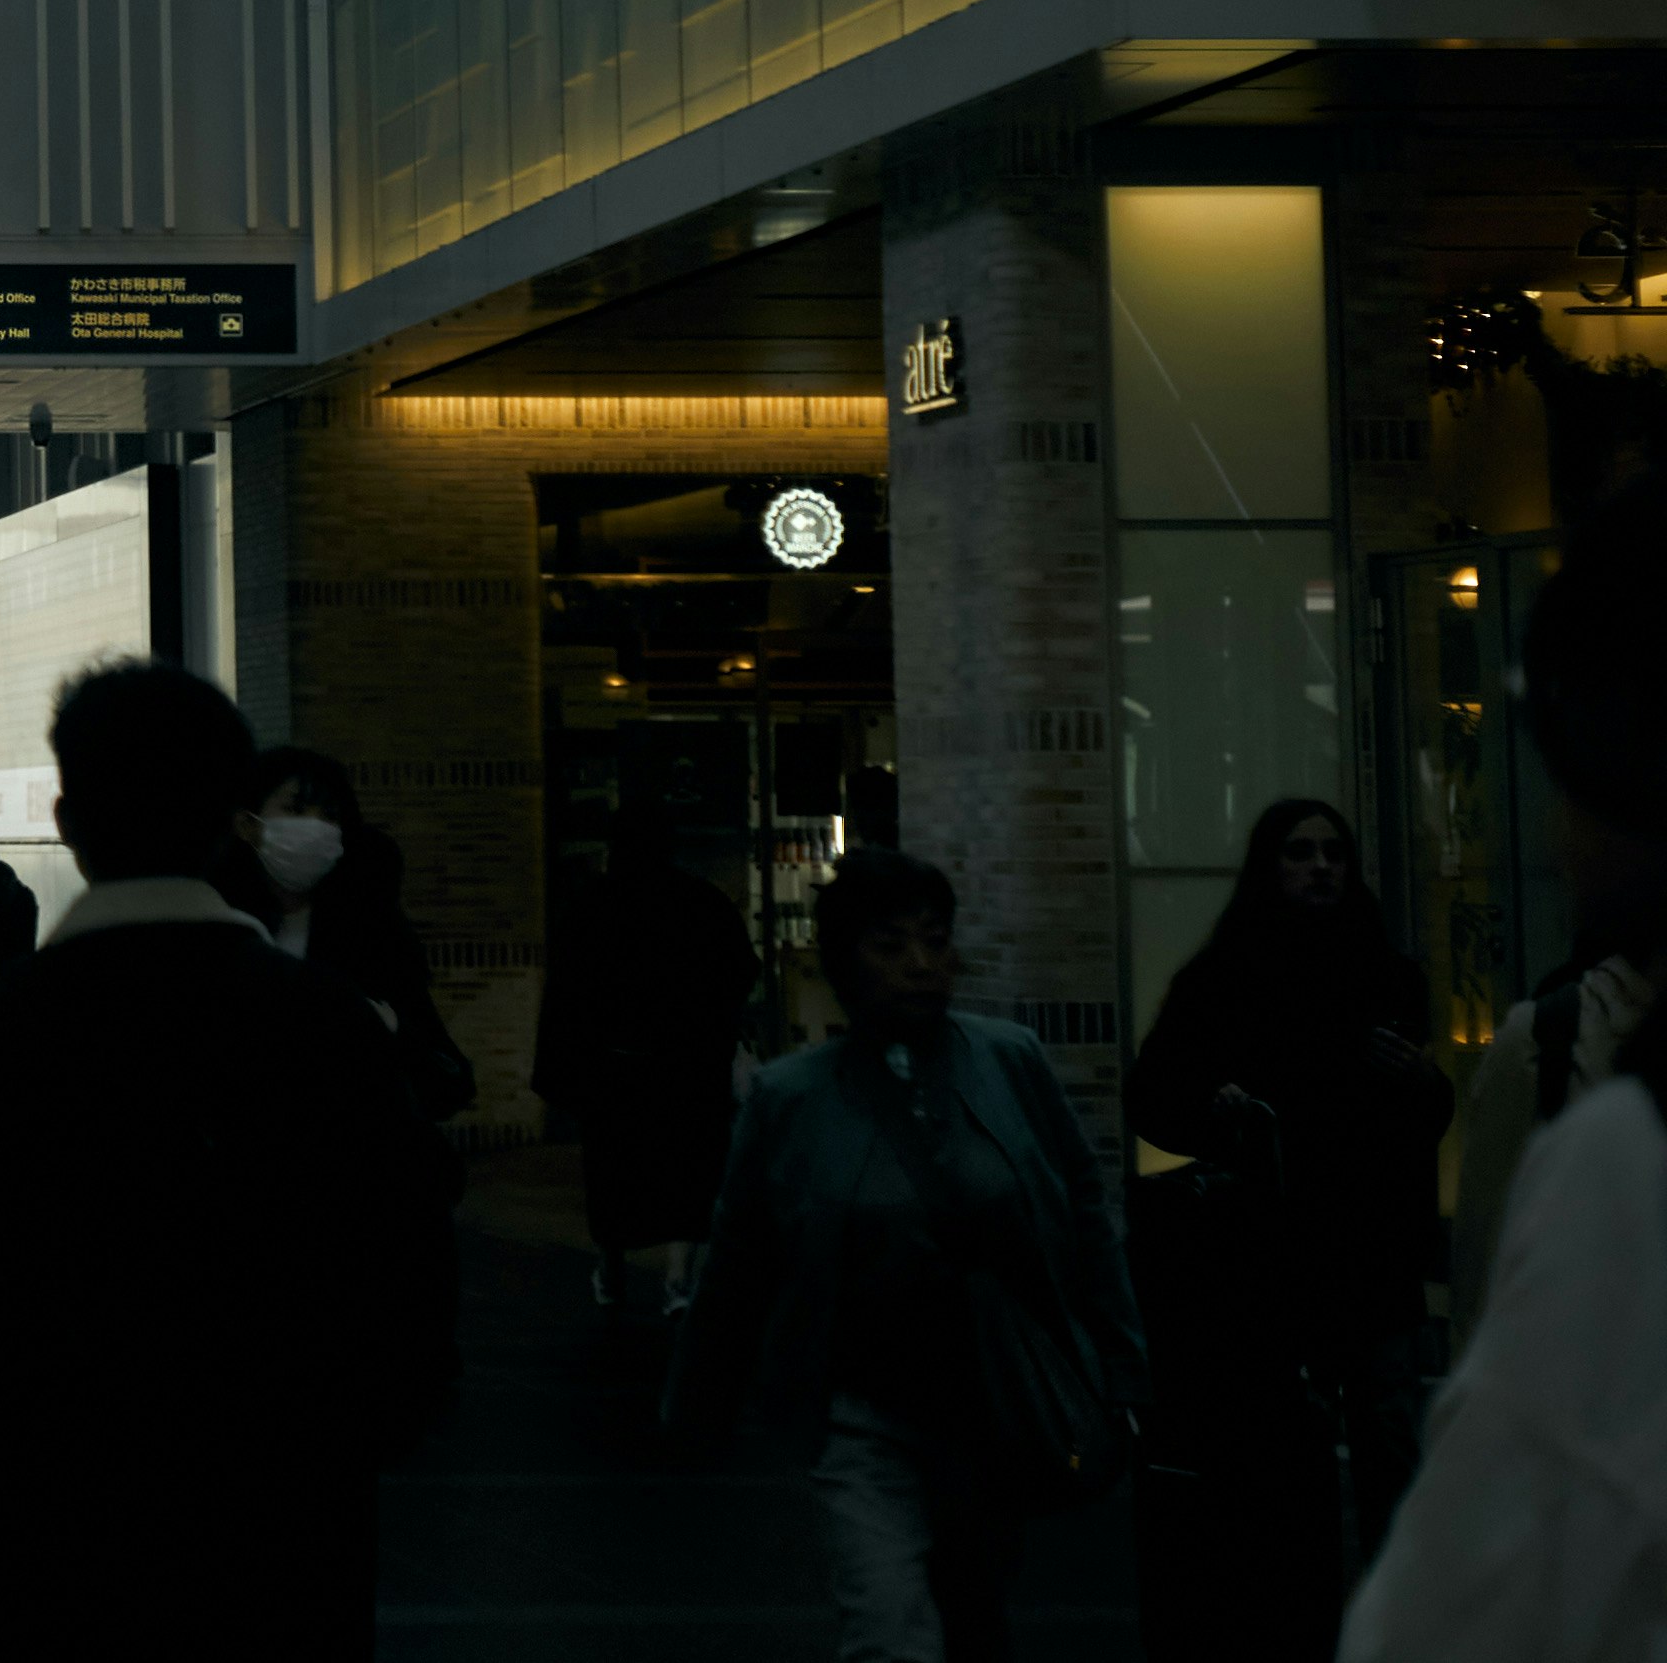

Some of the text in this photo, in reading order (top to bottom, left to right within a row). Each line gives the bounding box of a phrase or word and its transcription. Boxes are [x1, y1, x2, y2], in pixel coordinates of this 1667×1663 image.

[7, 293, 36, 304] Office
[71, 293, 243, 306] Kawasaki Municipal Taxation Office
[71, 313, 150, 327] 太田総合病院
[9, 328, 30, 339] Hall
[71, 328, 184, 340] Ota General Hospital
[903, 318, 955, 404] atré
